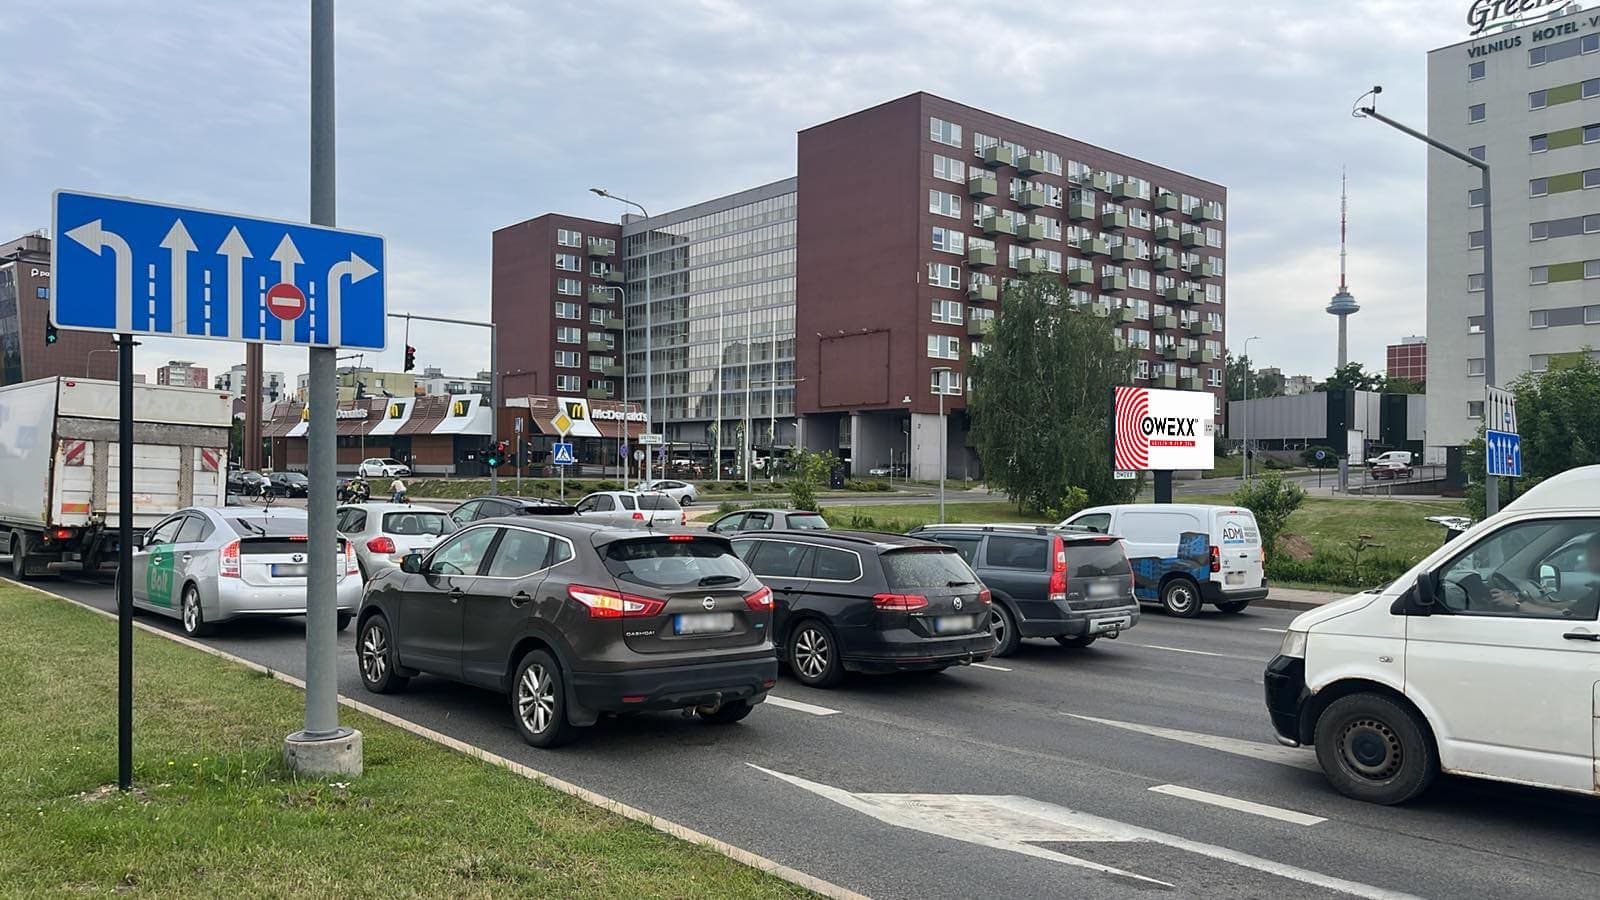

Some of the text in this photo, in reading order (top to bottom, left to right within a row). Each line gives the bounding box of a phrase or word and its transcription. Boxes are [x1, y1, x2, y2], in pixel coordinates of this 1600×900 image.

[1467, 35, 1522, 58] VILNIUS
[1532, 21, 1579, 43] HOTEL
[336, 409, 368, 419] Donald's
[591, 409, 648, 422] McDonald's
[1142, 416, 1195, 437] OWEXX
[1223, 526, 1244, 540] ADMI
[151, 567, 168, 593] Bolt
